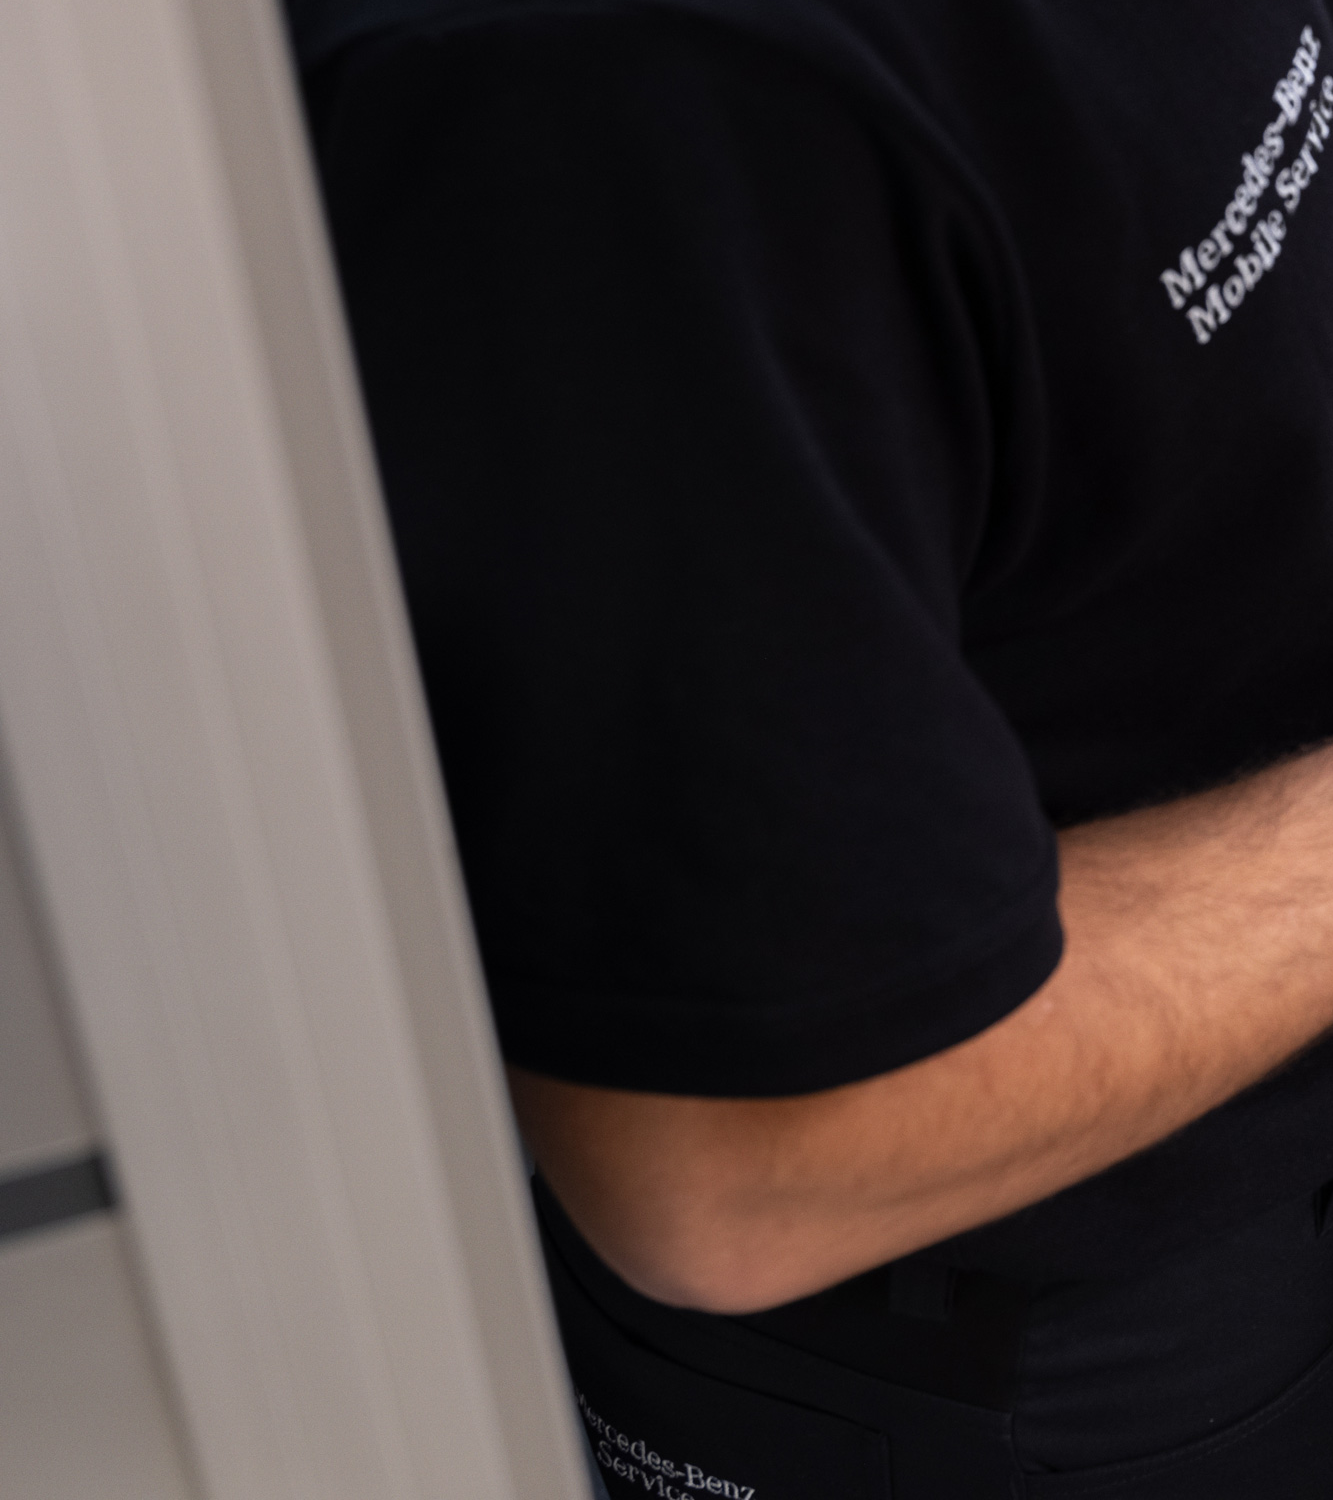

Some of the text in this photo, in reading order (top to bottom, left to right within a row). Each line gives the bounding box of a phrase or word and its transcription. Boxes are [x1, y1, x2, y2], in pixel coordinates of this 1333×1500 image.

[1159, 24, 1321, 310] Mercedes-Benz
[1185, 209, 1288, 346] Mobile
[597, 1440, 695, 1500] Service
